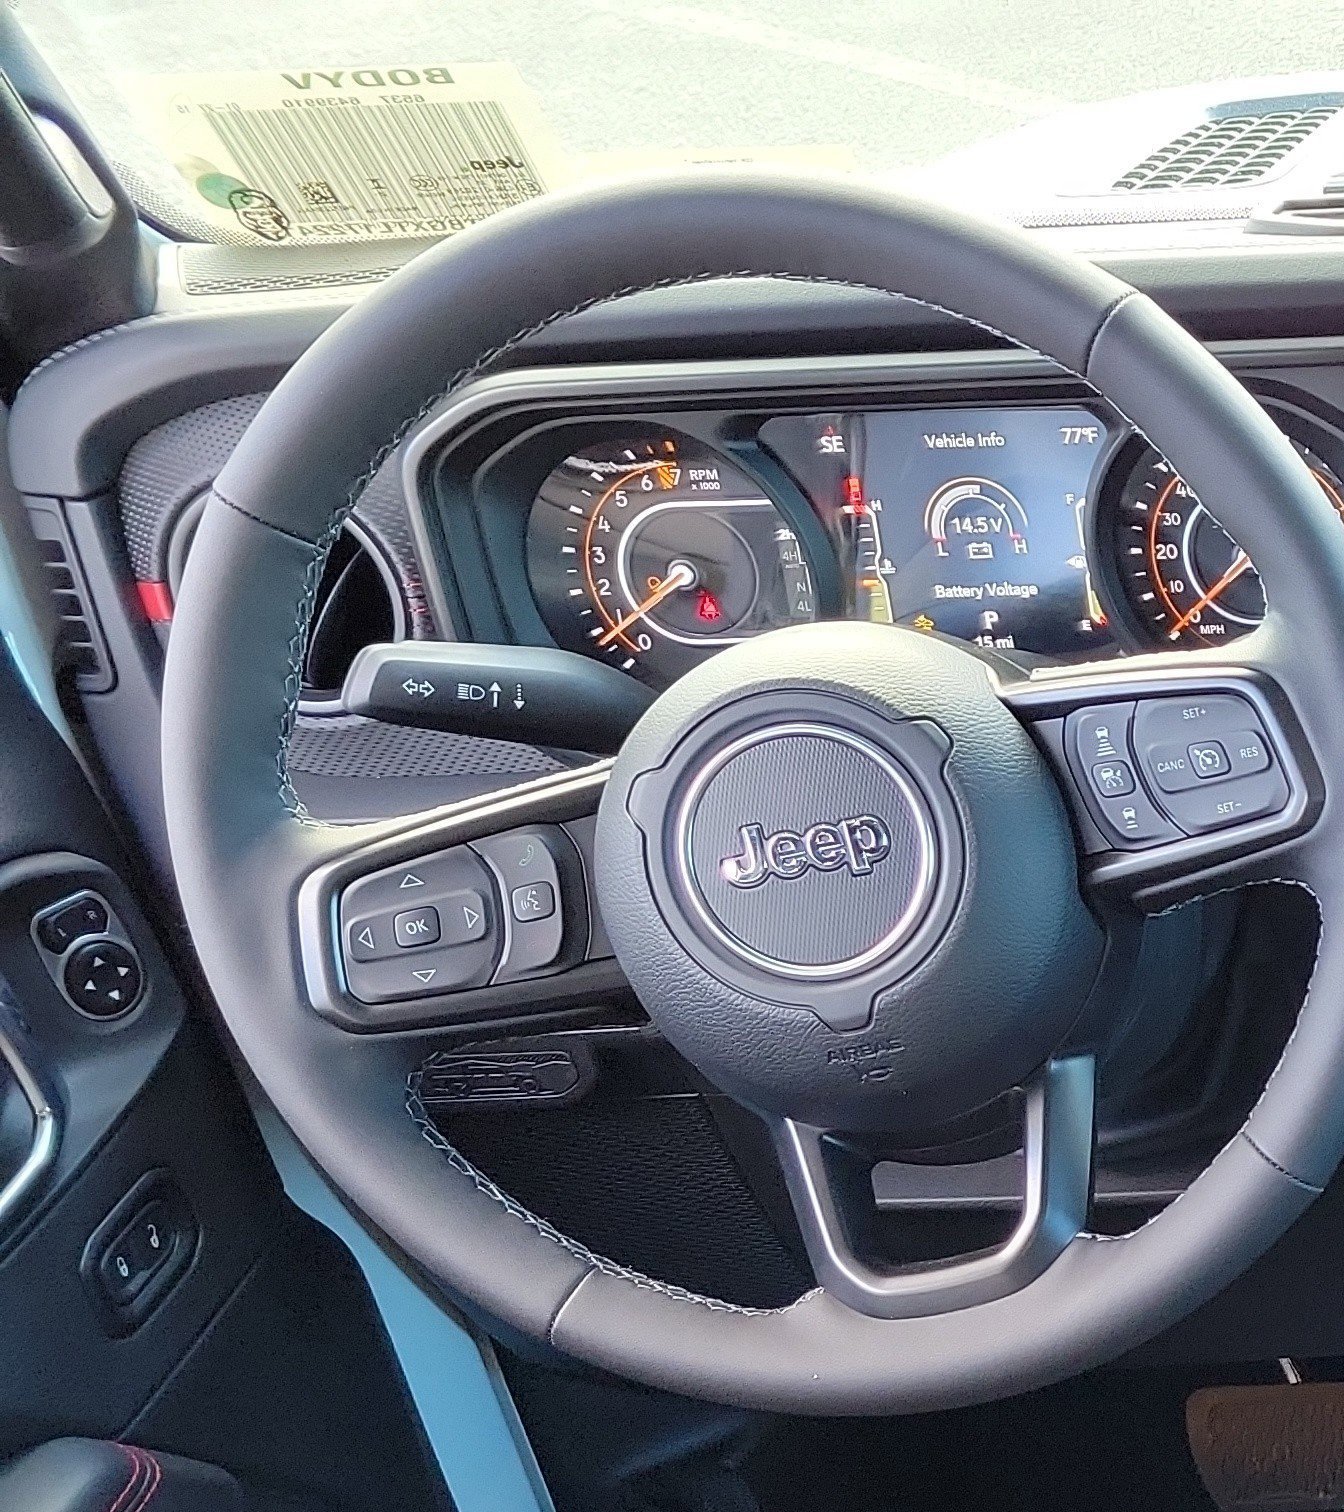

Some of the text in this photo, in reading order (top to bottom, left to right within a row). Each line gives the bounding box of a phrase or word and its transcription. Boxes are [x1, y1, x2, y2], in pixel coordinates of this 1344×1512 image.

[819, 436, 846, 453] SE
[923, 432, 1005, 450] Vehicle Info
[641, 474, 654, 491] 6
[669, 468, 682, 486] 7
[689, 468, 719, 481] RPM
[699, 481, 721, 491] 1000
[615, 490, 628, 507] 5
[598, 516, 611, 533] 4
[951, 517, 1003, 535] 14.5 V
[1162, 511, 1182, 527] 30
[593, 547, 606, 564] 3
[1155, 543, 1178, 561] 20
[598, 578, 612, 596] 2
[796, 581, 807, 592] N
[934, 582, 1039, 600] Battery Voltage
[1169, 580, 1185, 594] 10
[983, 610, 999, 630] P
[1200, 624, 1226, 636] MPH
[637, 633, 652, 650] 0
[995, 634, 1015, 648] mi
[1239, 746, 1259, 759] RES
[1157, 759, 1185, 773] CANC
[721, 813, 892, 888] Jeep
[405, 917, 429, 937] OK
